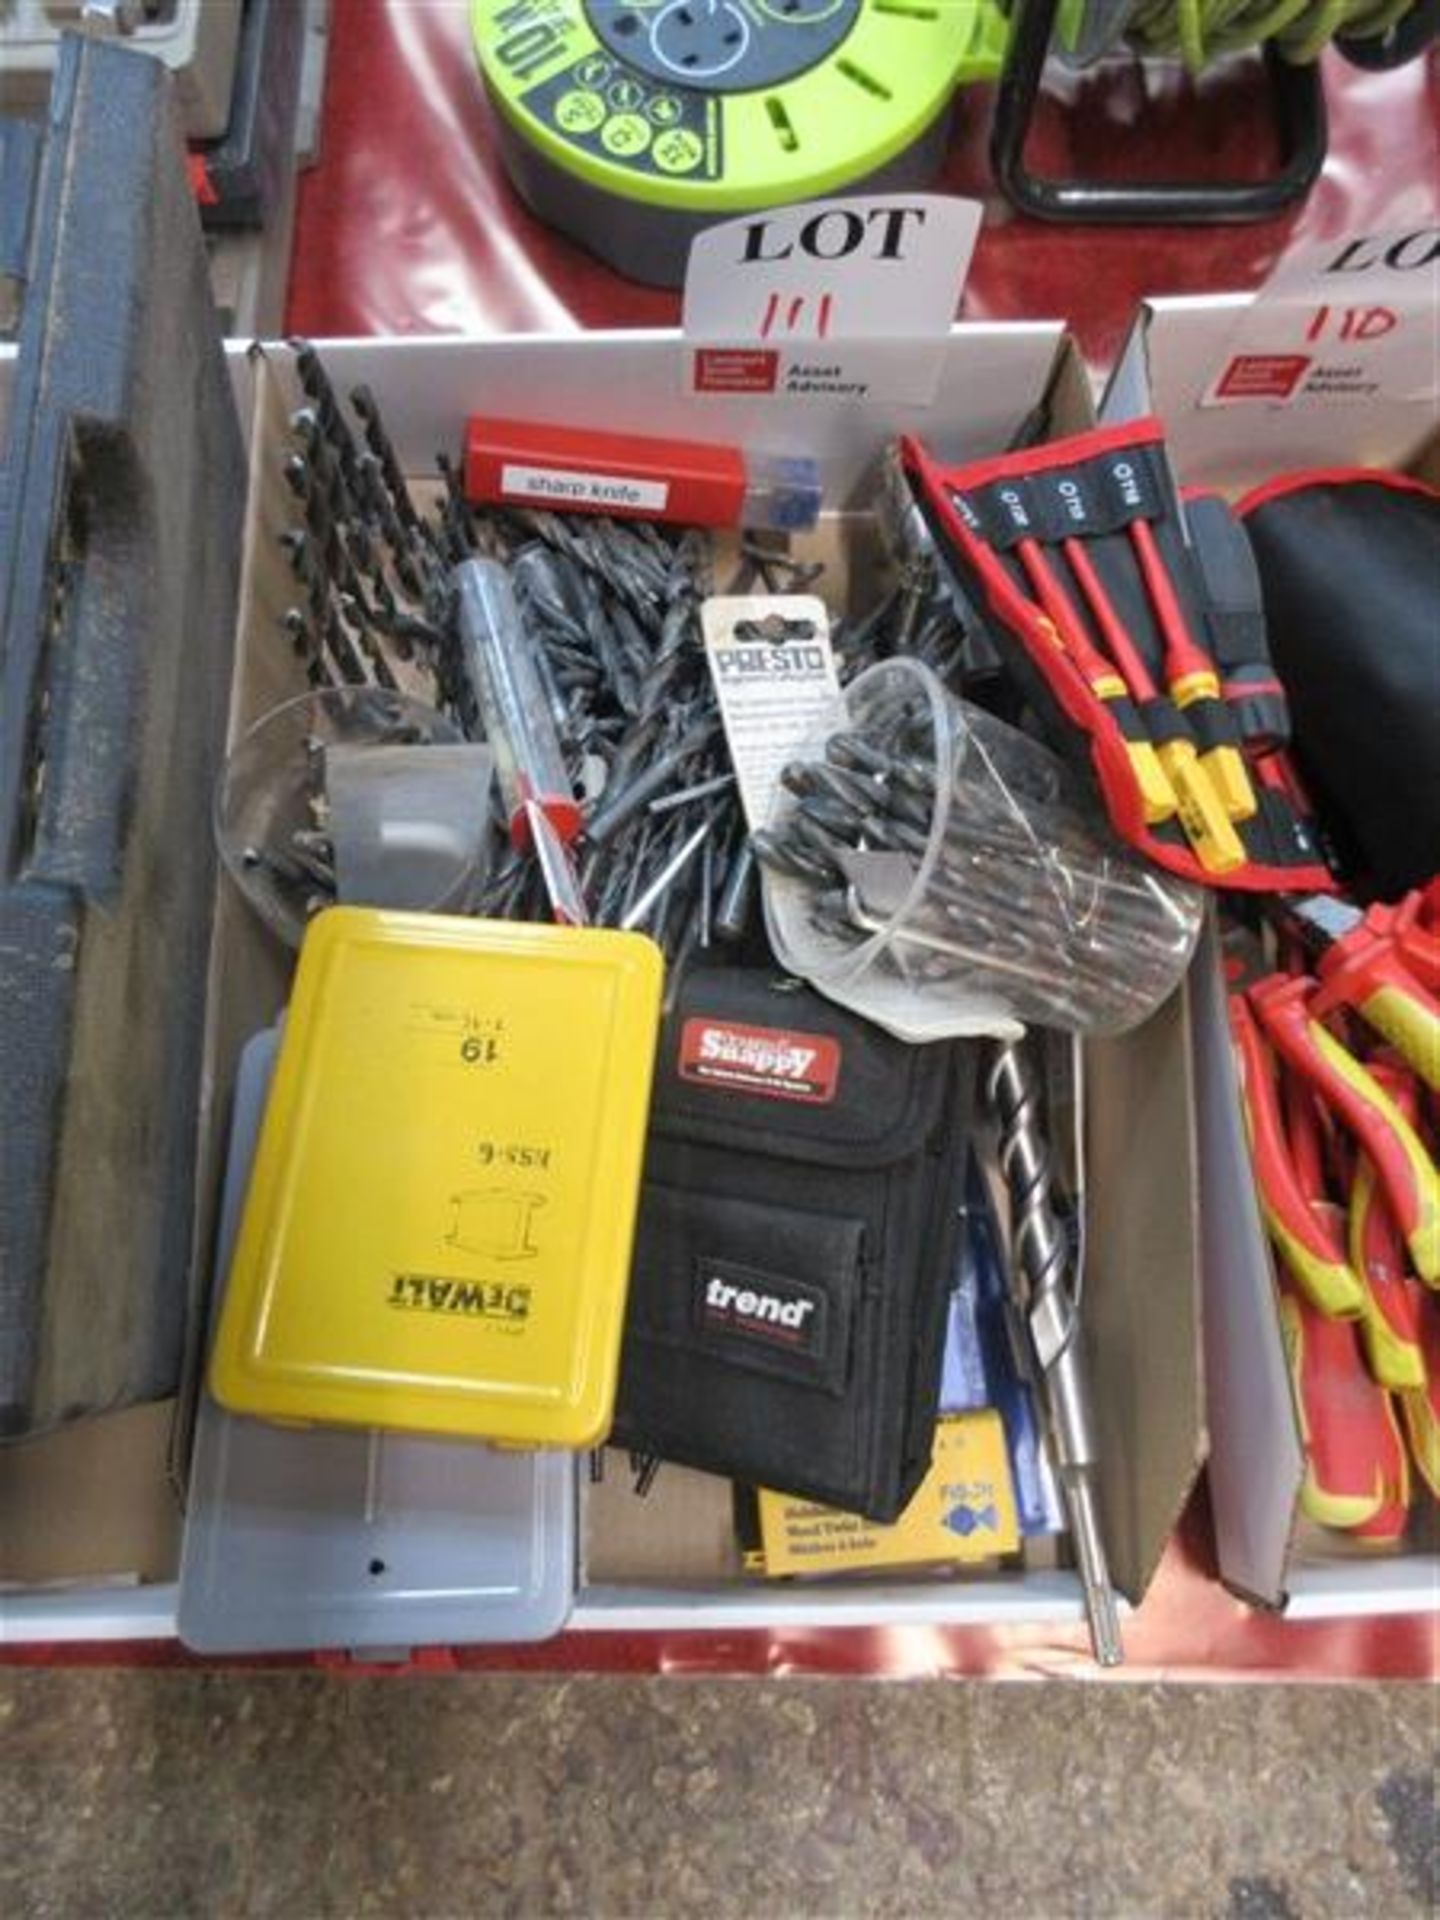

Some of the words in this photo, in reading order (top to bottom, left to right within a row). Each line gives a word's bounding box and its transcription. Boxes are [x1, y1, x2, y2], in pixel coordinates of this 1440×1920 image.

[737, 207, 926, 264] LOT
[1323, 230, 1440, 273] LO
[759, 293, 832, 339] 111
[787, 380, 868, 395] Advisory
[527, 477, 586, 495] sharp
[591, 482, 641, 502] knife
[715, 648, 826, 672] PRESTO
[461, 1037, 497, 1063] 19
[706, 1278, 814, 1329] trend
